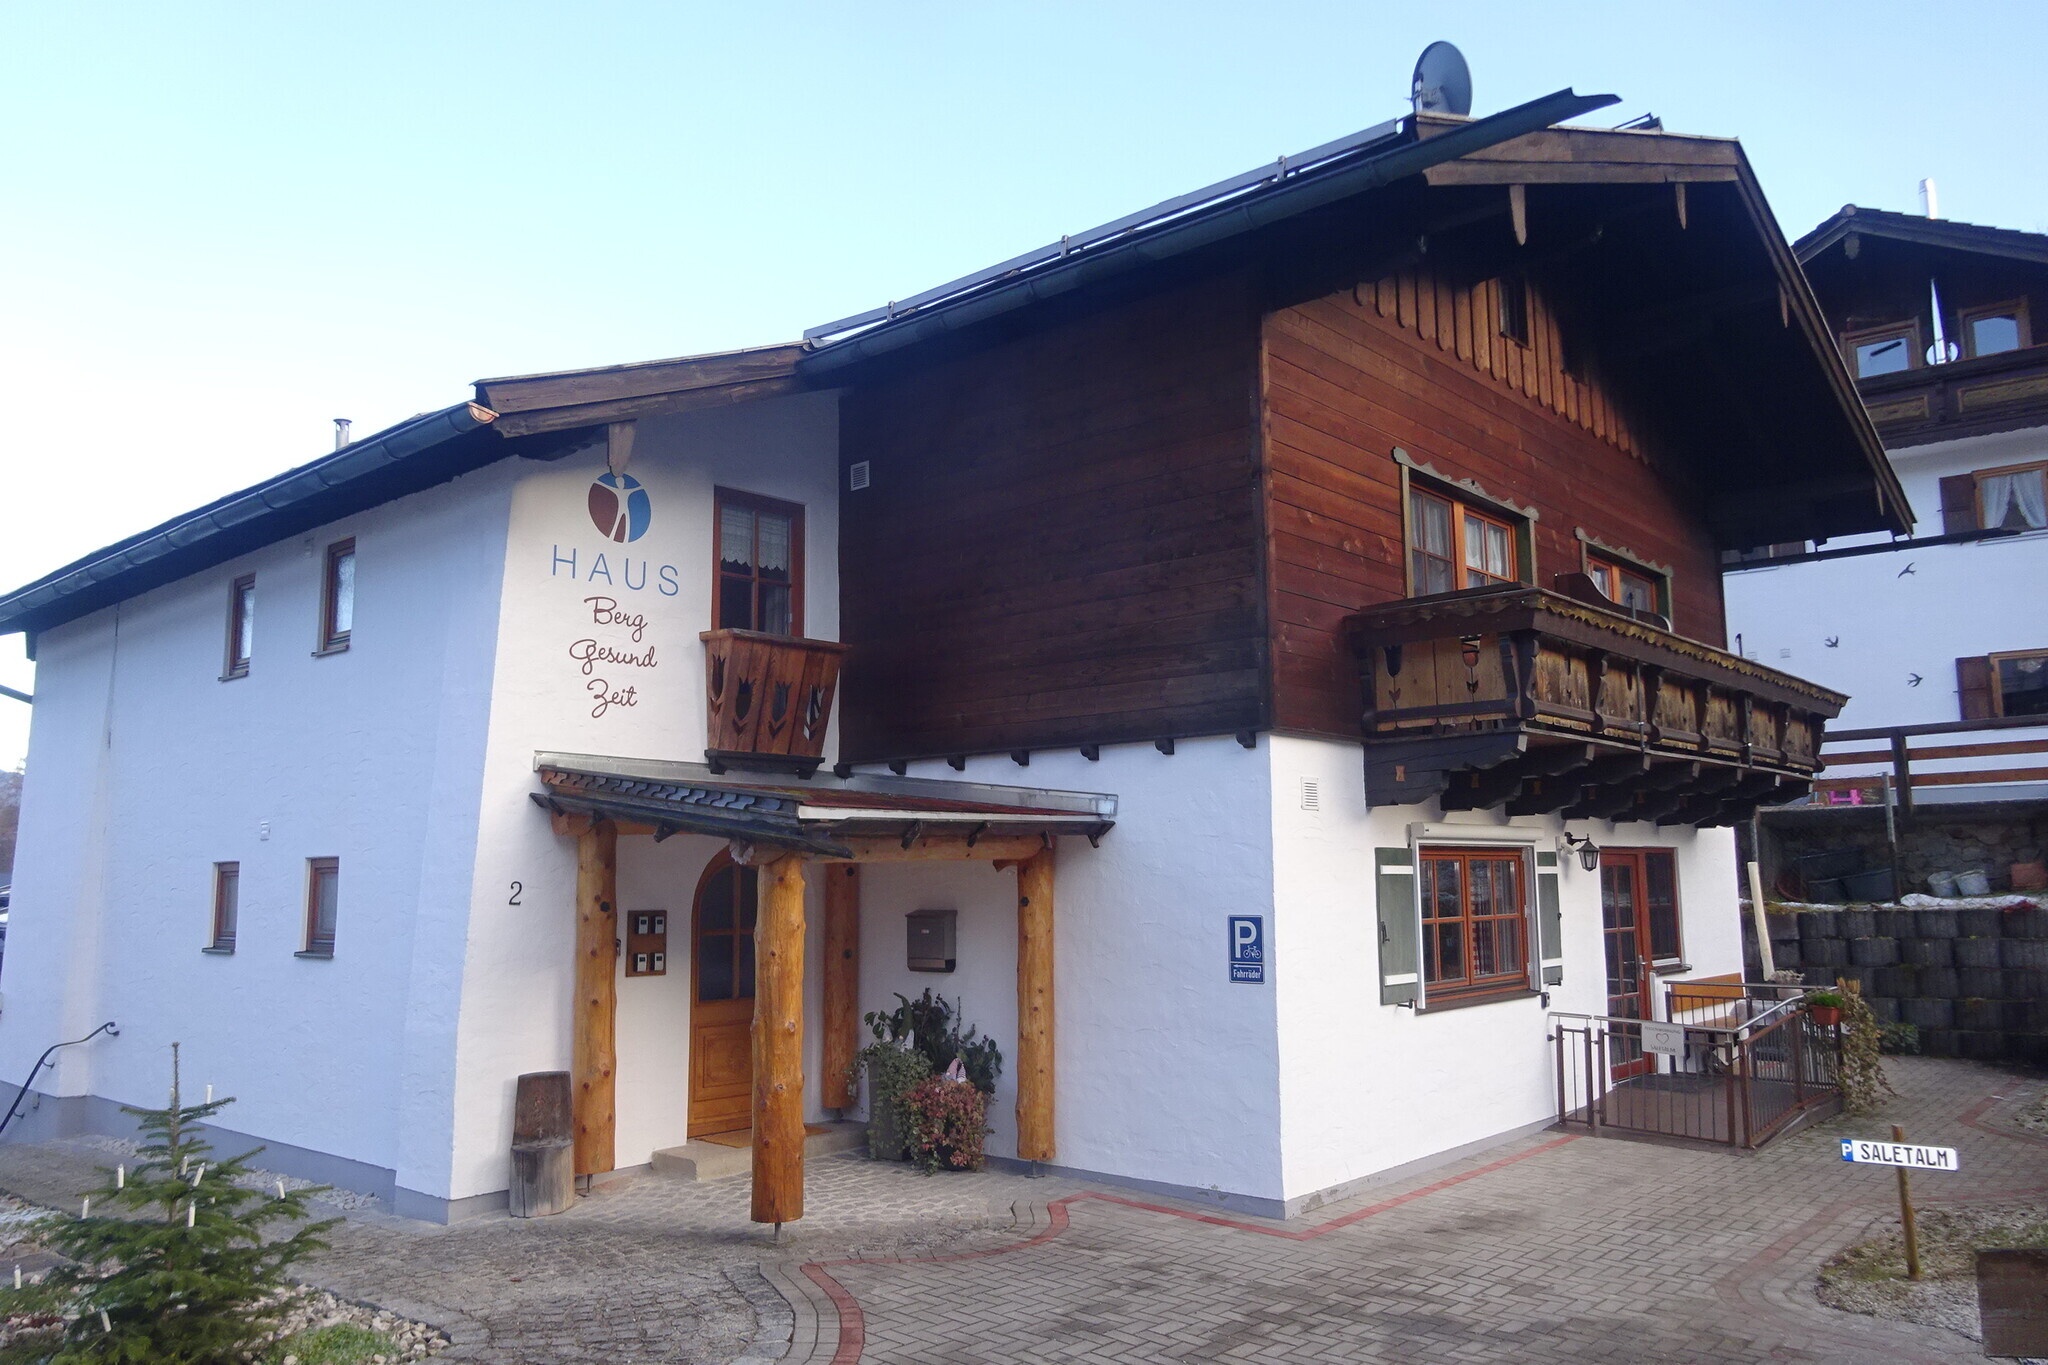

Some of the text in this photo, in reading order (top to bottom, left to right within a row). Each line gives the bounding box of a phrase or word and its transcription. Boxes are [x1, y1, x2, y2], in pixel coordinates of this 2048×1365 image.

[552, 544, 679, 596] HAUS
[583, 596, 648, 643] Berg
[569, 638, 658, 675] Gesund
[586, 678, 638, 719] Zeit
[508, 881, 523, 906] 2
[1234, 920, 1257, 958] P
[1233, 968, 1261, 979] Fahrräder
[1841, 1143, 1949, 1167] P SALETALM
